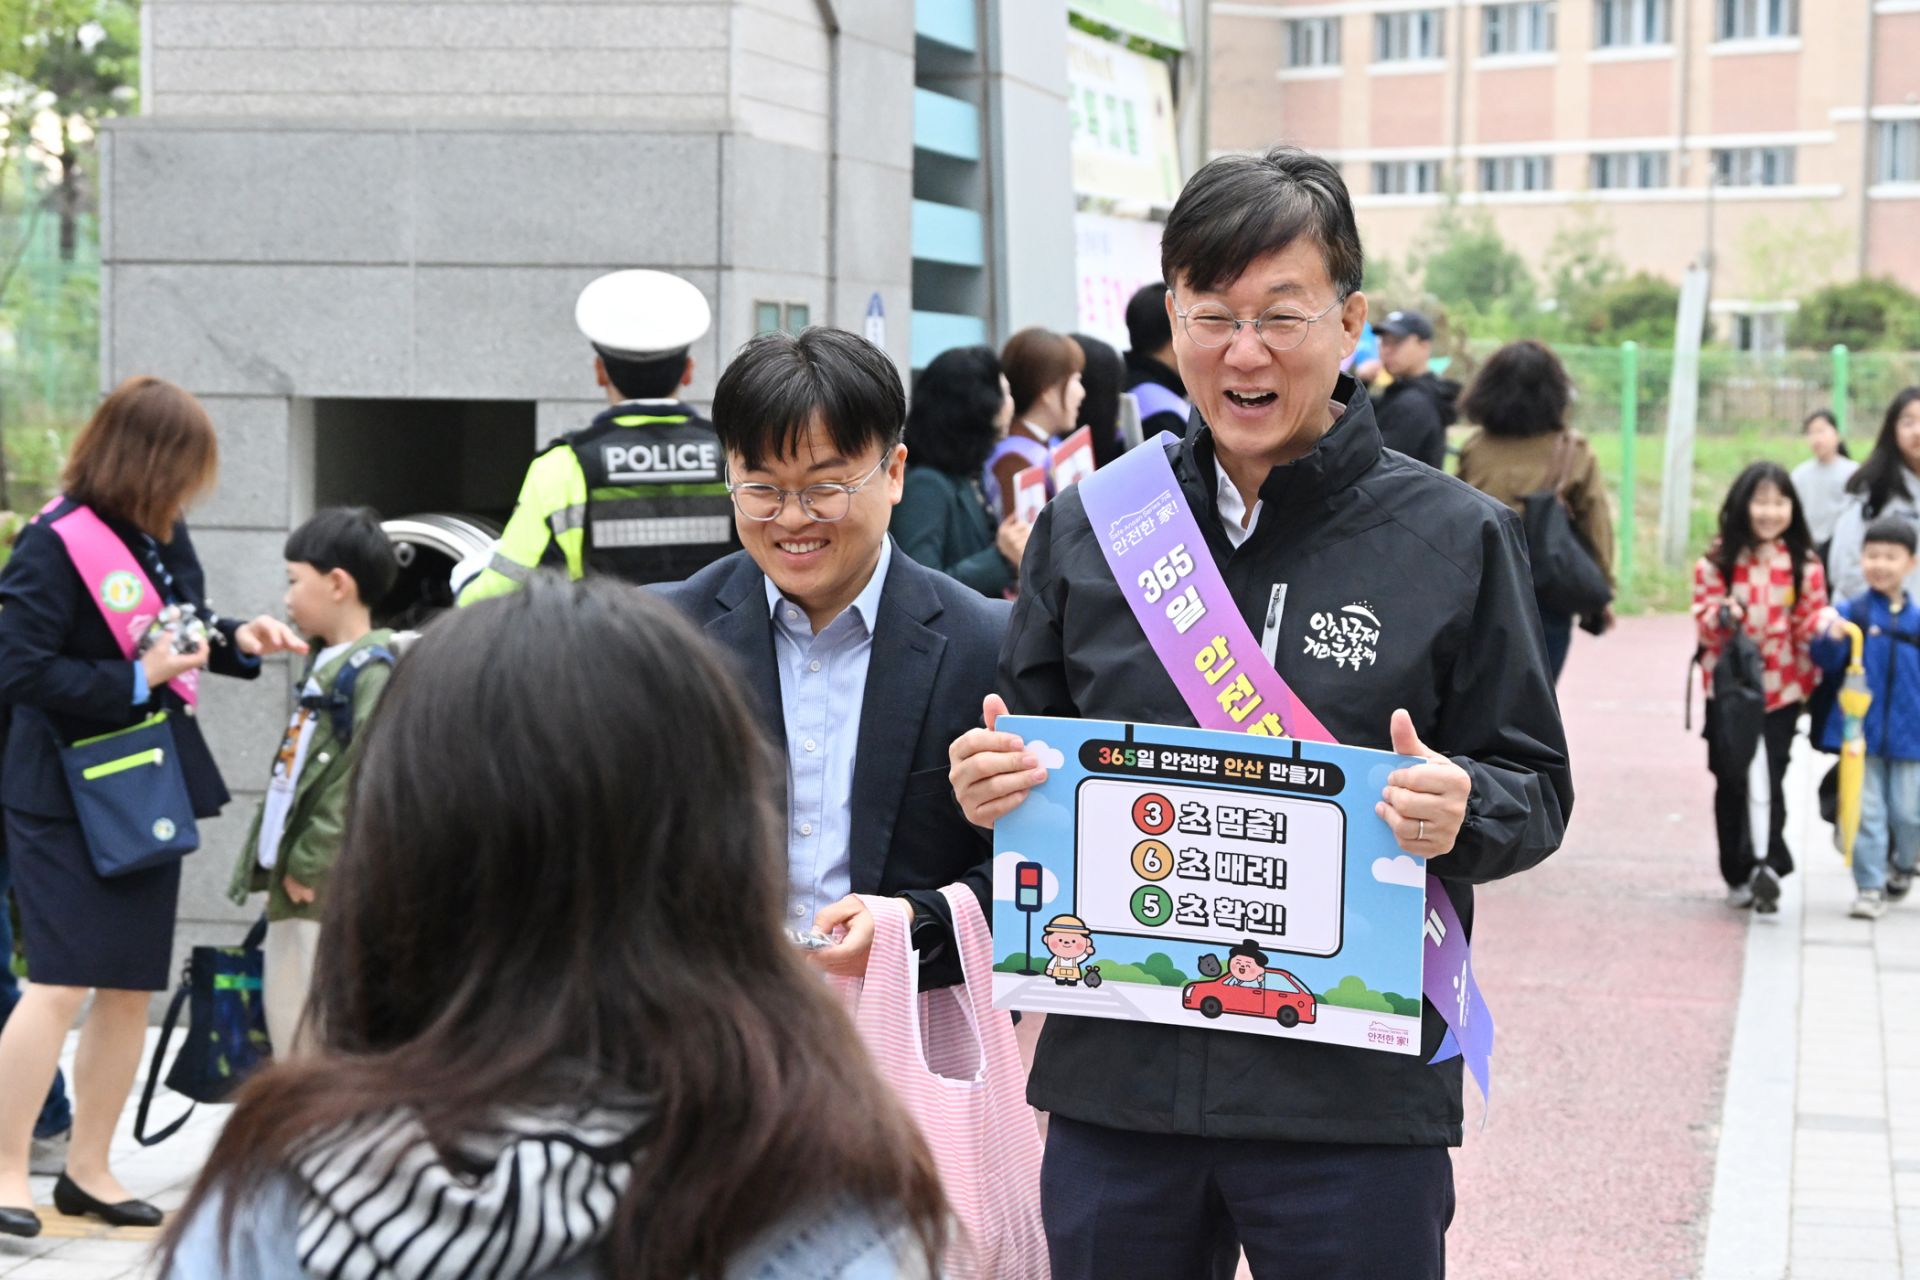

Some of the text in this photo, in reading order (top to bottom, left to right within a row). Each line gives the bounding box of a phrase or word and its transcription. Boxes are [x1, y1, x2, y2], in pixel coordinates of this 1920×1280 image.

[605, 443, 717, 472] POLICE
[1112, 516, 1156, 557] 안전한
[1309, 611, 1380, 647] 안산국제
[1303, 635, 1377, 671] 거리극축제
[1098, 746, 1326, 787] 365일 안전한 안산 만들기
[1216, 805, 1287, 844] 멈춤!
[1215, 851, 1287, 890] 배려!
[1214, 896, 1287, 936] 확인!
[1367, 1032, 1395, 1045] 안전한
